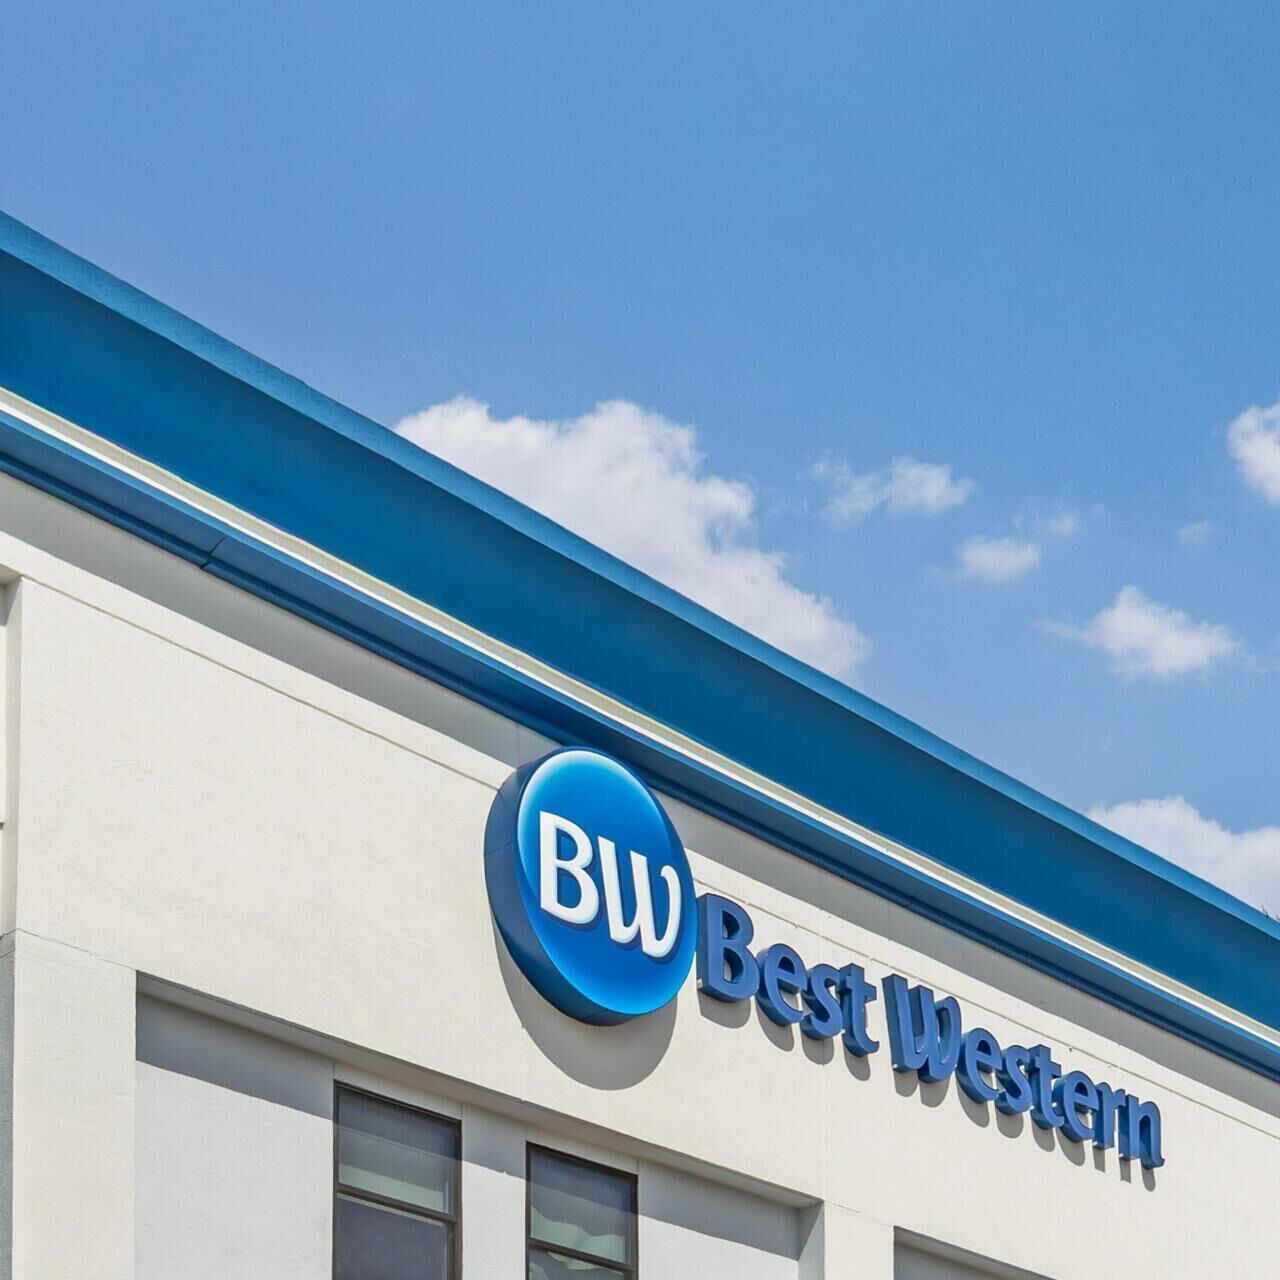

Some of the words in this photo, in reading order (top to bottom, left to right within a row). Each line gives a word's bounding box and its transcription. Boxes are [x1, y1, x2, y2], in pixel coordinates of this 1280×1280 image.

[539, 811, 682, 958] BW
[697, 893, 880, 1057] Best
[883, 974, 1166, 1169] Western
